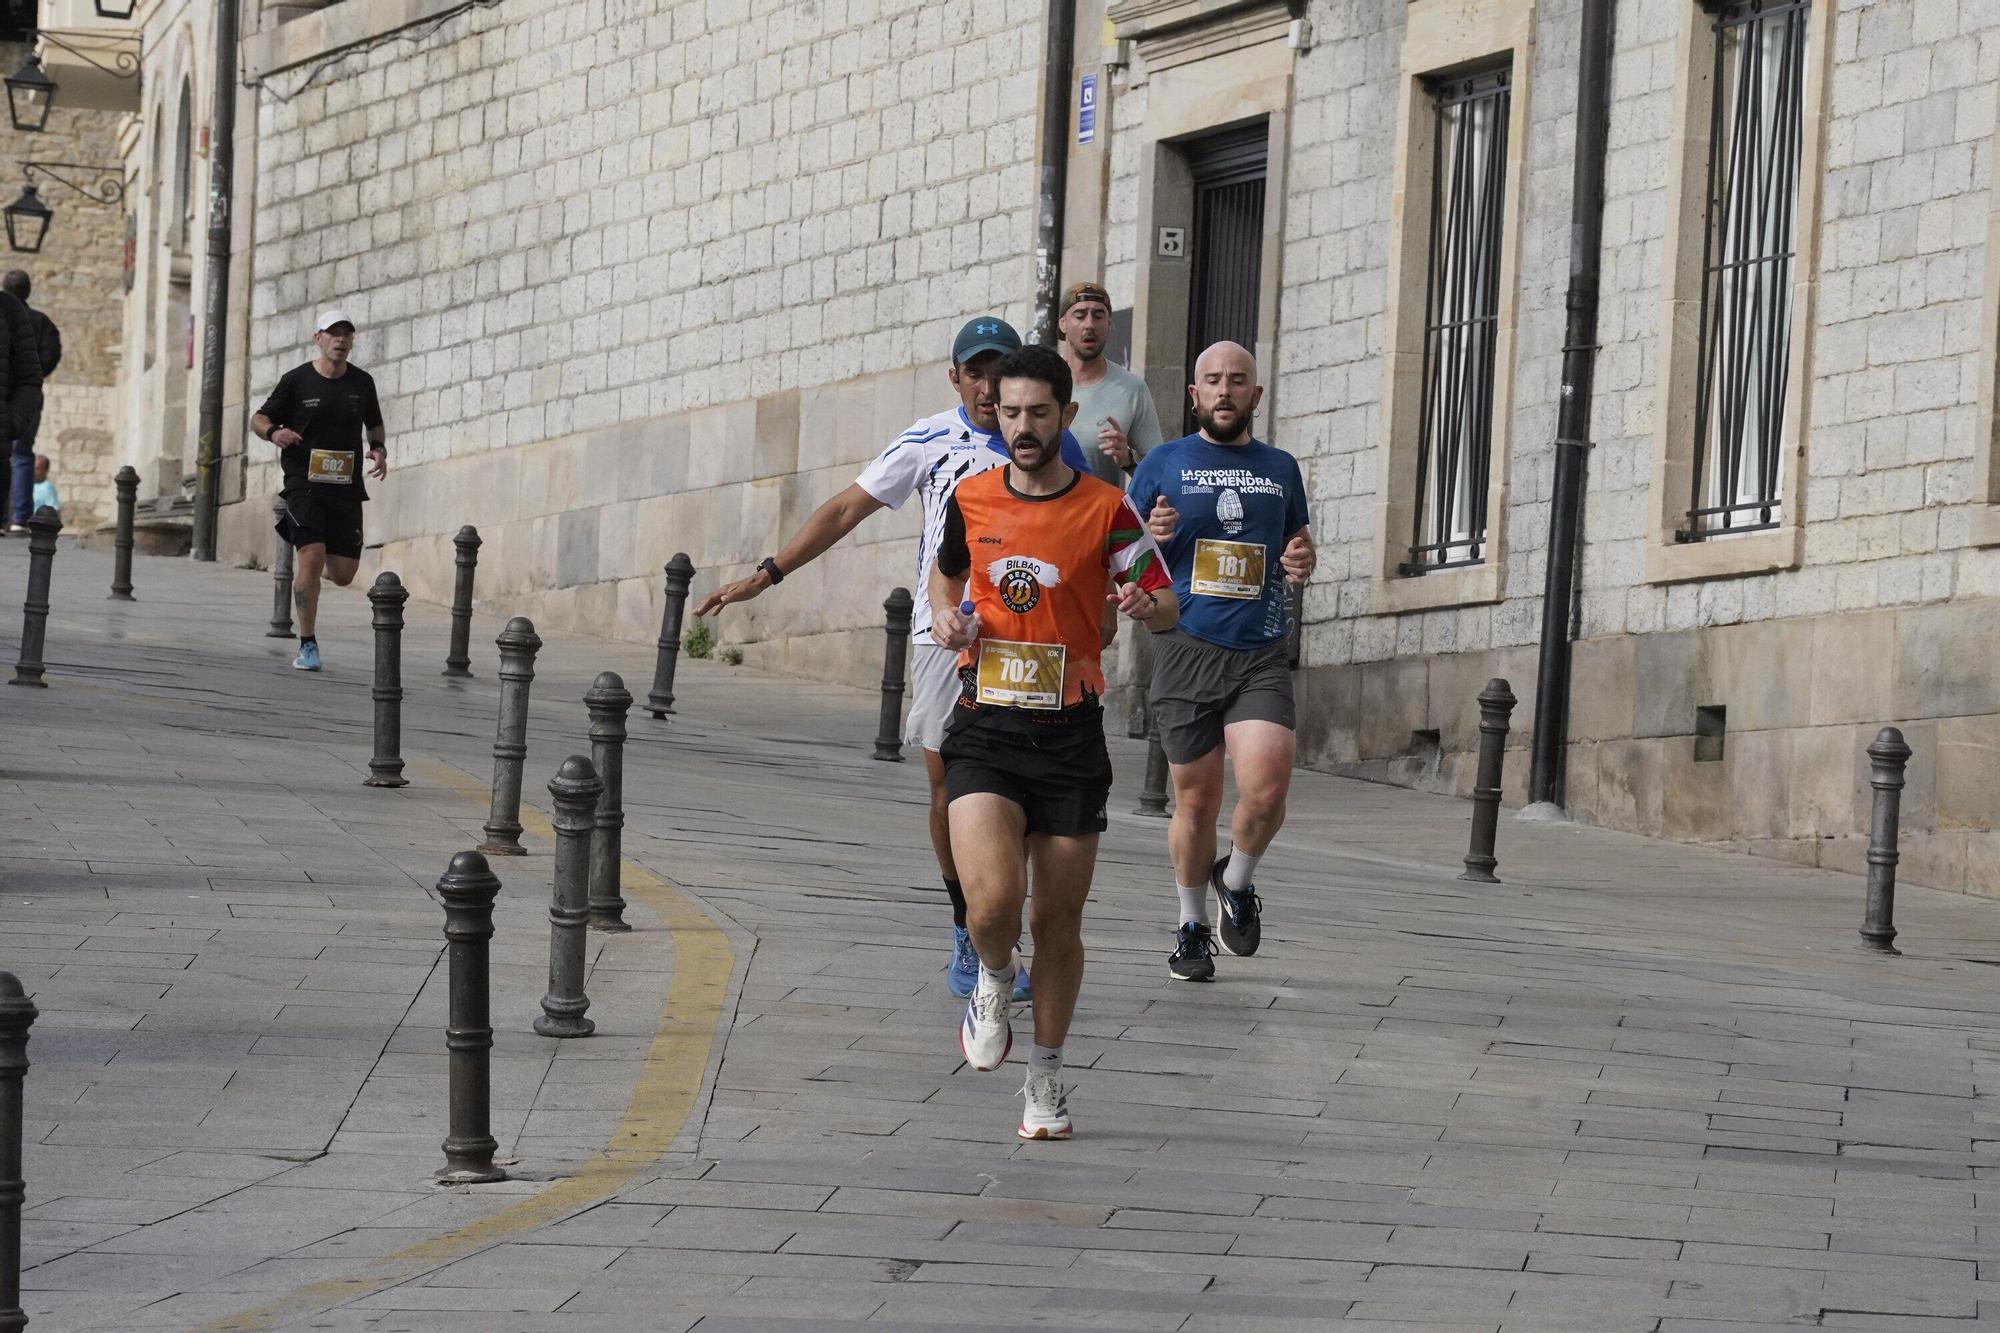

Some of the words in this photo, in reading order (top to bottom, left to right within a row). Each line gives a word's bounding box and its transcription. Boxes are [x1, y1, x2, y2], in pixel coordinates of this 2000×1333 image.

[321, 458, 345, 472] 602
[1181, 469, 1194, 477] LA
[1194, 469, 1253, 478] CONQUISTA
[1198, 476, 1274, 487] ALMENDRA
[1240, 486, 1284, 498] KONKISTA
[1006, 560, 1041, 575] BILBAO
[1216, 555, 1248, 579] 181
[1007, 571, 1033, 582] BEER
[1002, 593, 1038, 612] RUNNERS
[1047, 649, 1059, 658] 10K
[999, 656, 1039, 684] 702
